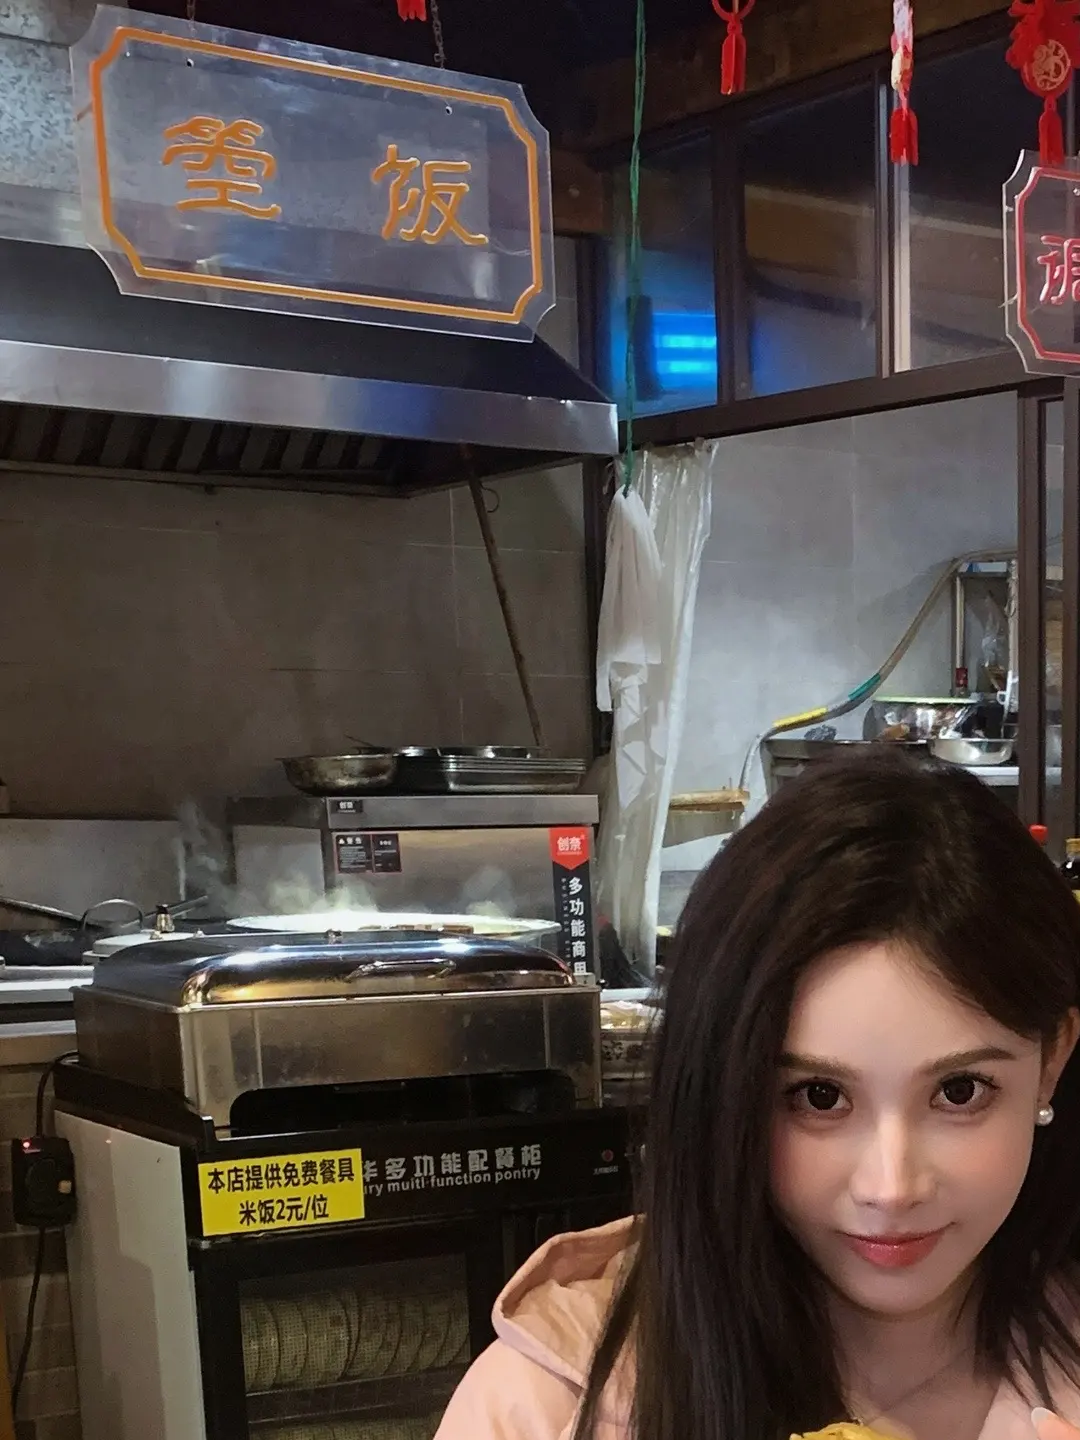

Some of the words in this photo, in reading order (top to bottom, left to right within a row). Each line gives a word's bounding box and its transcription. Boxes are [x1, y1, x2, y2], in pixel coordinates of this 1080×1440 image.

[207, 1158, 355, 1194] 本店提供免费餐具
[495, 1168, 541, 1184] pontry
[239, 1194, 330, 1227] 米饭2元/位
